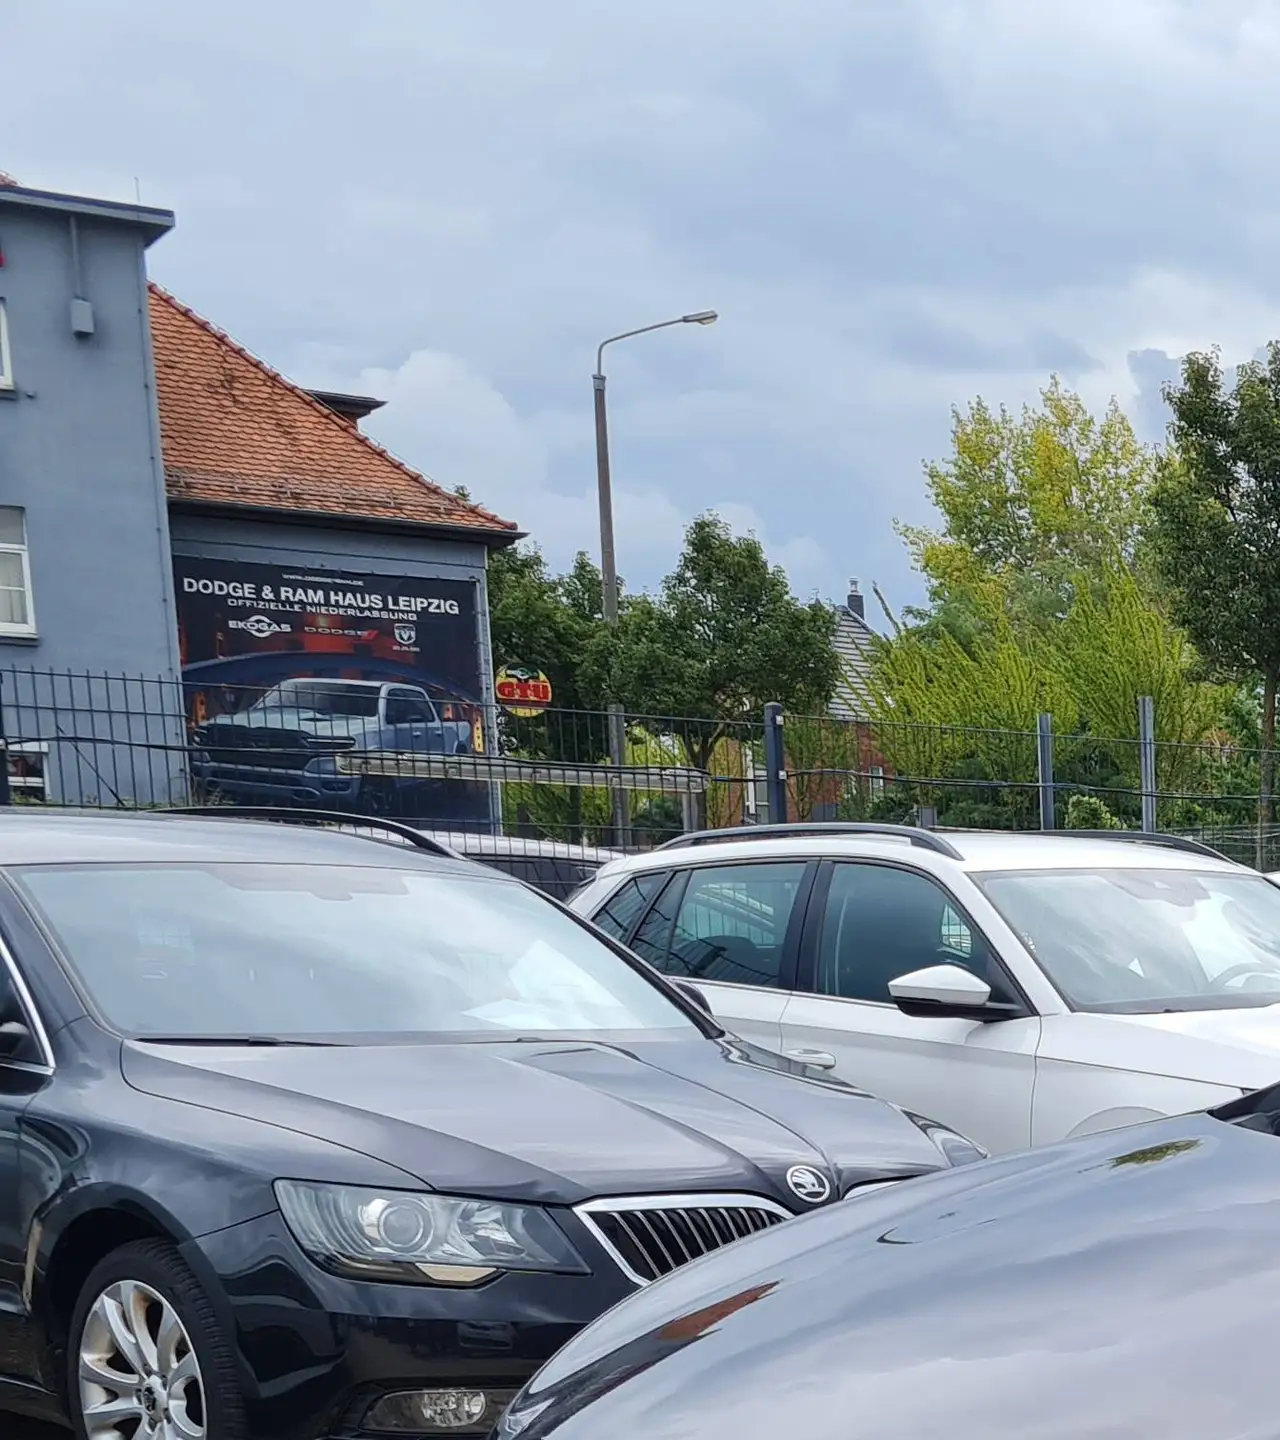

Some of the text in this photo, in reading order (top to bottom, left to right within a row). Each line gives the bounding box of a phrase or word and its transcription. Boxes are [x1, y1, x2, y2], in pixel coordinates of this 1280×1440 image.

[183, 577, 460, 615] DODGE & RAM HAUS LEIPZIG
[227, 598, 418, 621] OFFIZIELLE NIEDERLASSUNG
[228, 620, 292, 632] EKOGAS
